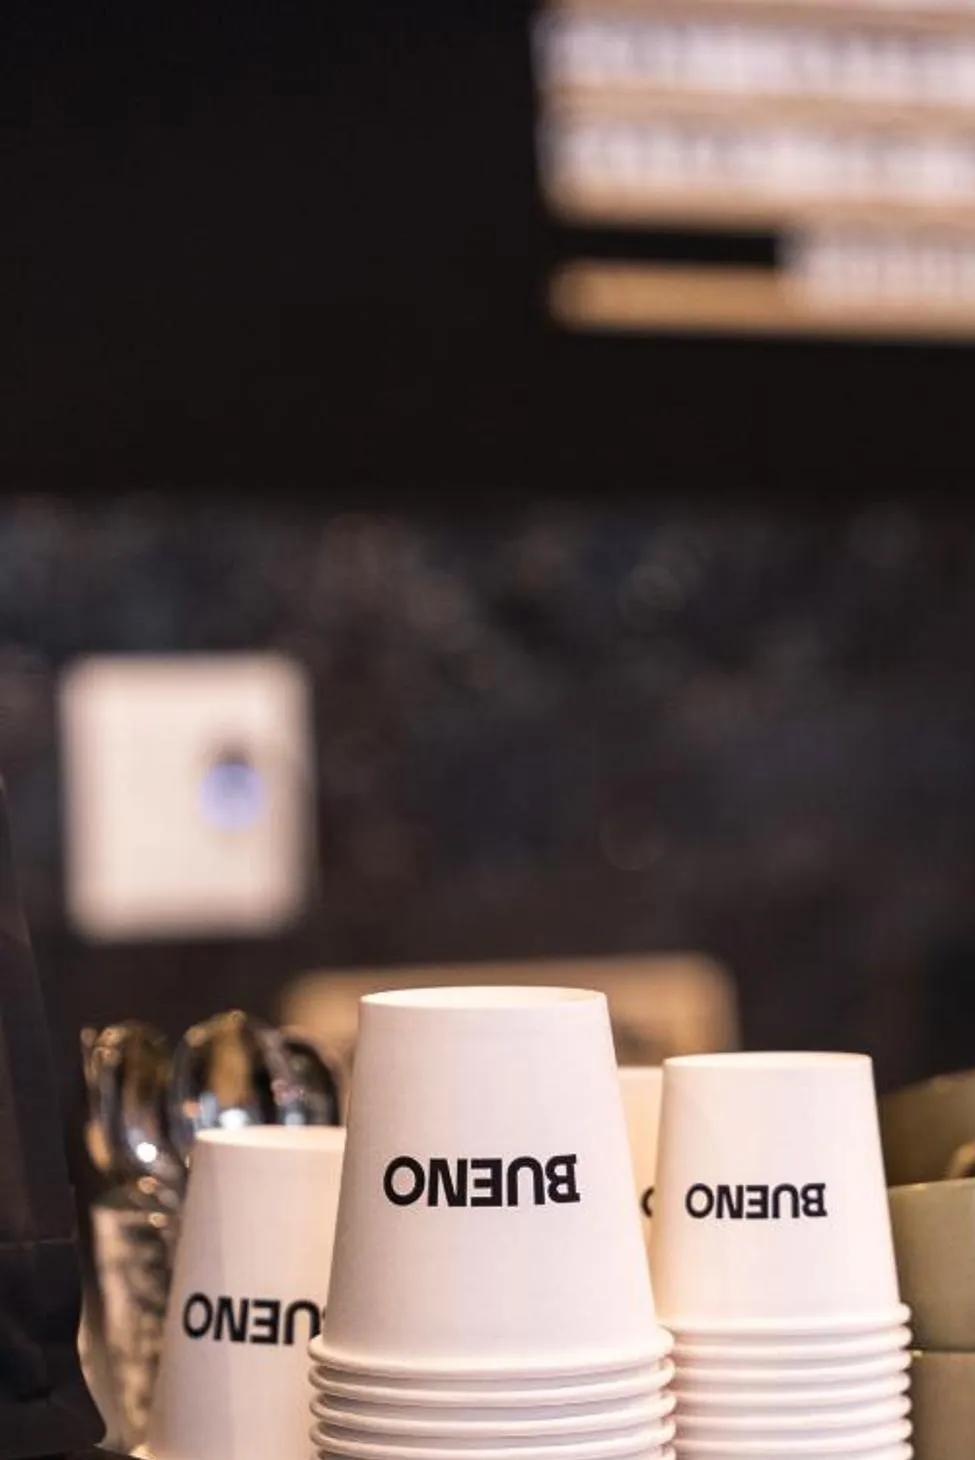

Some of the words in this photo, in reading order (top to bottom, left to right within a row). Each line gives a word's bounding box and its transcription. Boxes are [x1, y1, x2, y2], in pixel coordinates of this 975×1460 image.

[383, 1154, 581, 1208] BUENO
[685, 1182, 828, 1219] BUENO
[182, 1291, 327, 1346] UENO
